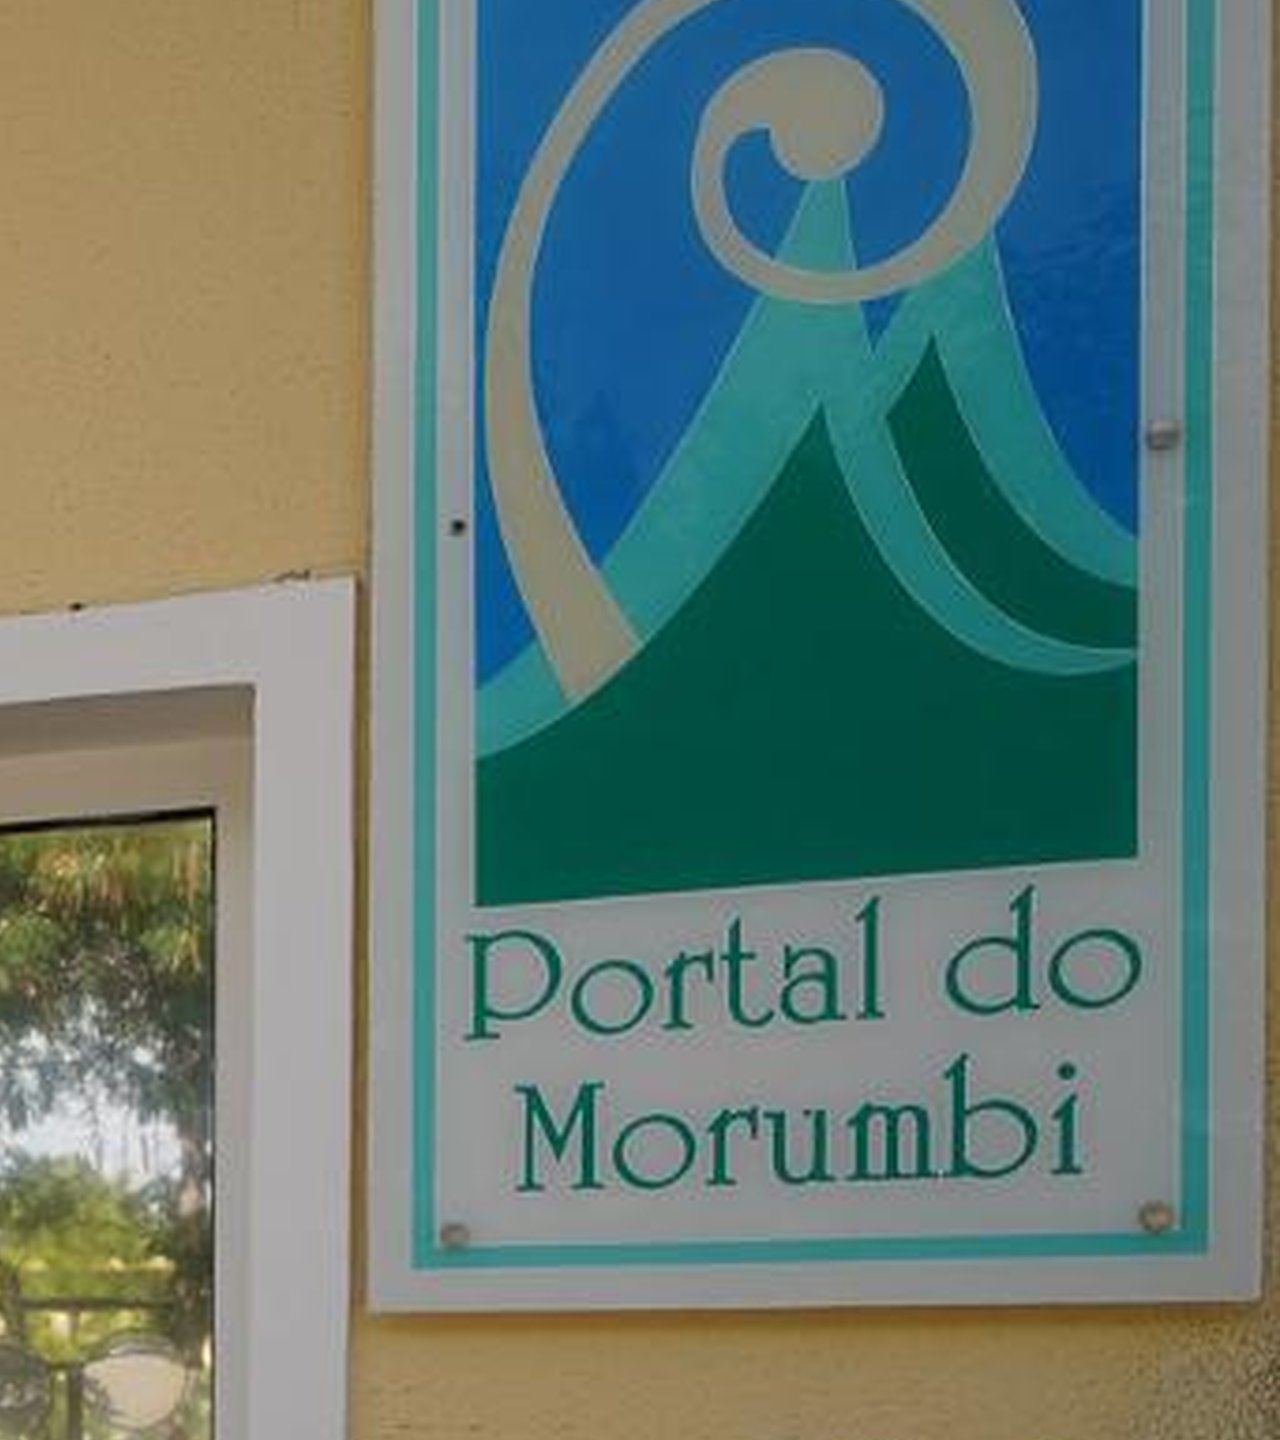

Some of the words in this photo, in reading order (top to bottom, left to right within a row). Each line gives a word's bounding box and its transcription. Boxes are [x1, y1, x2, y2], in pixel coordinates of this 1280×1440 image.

[463, 896, 885, 1041] Portal
[946, 885, 1141, 1011] do
[515, 1054, 1084, 1191] Morumbi
